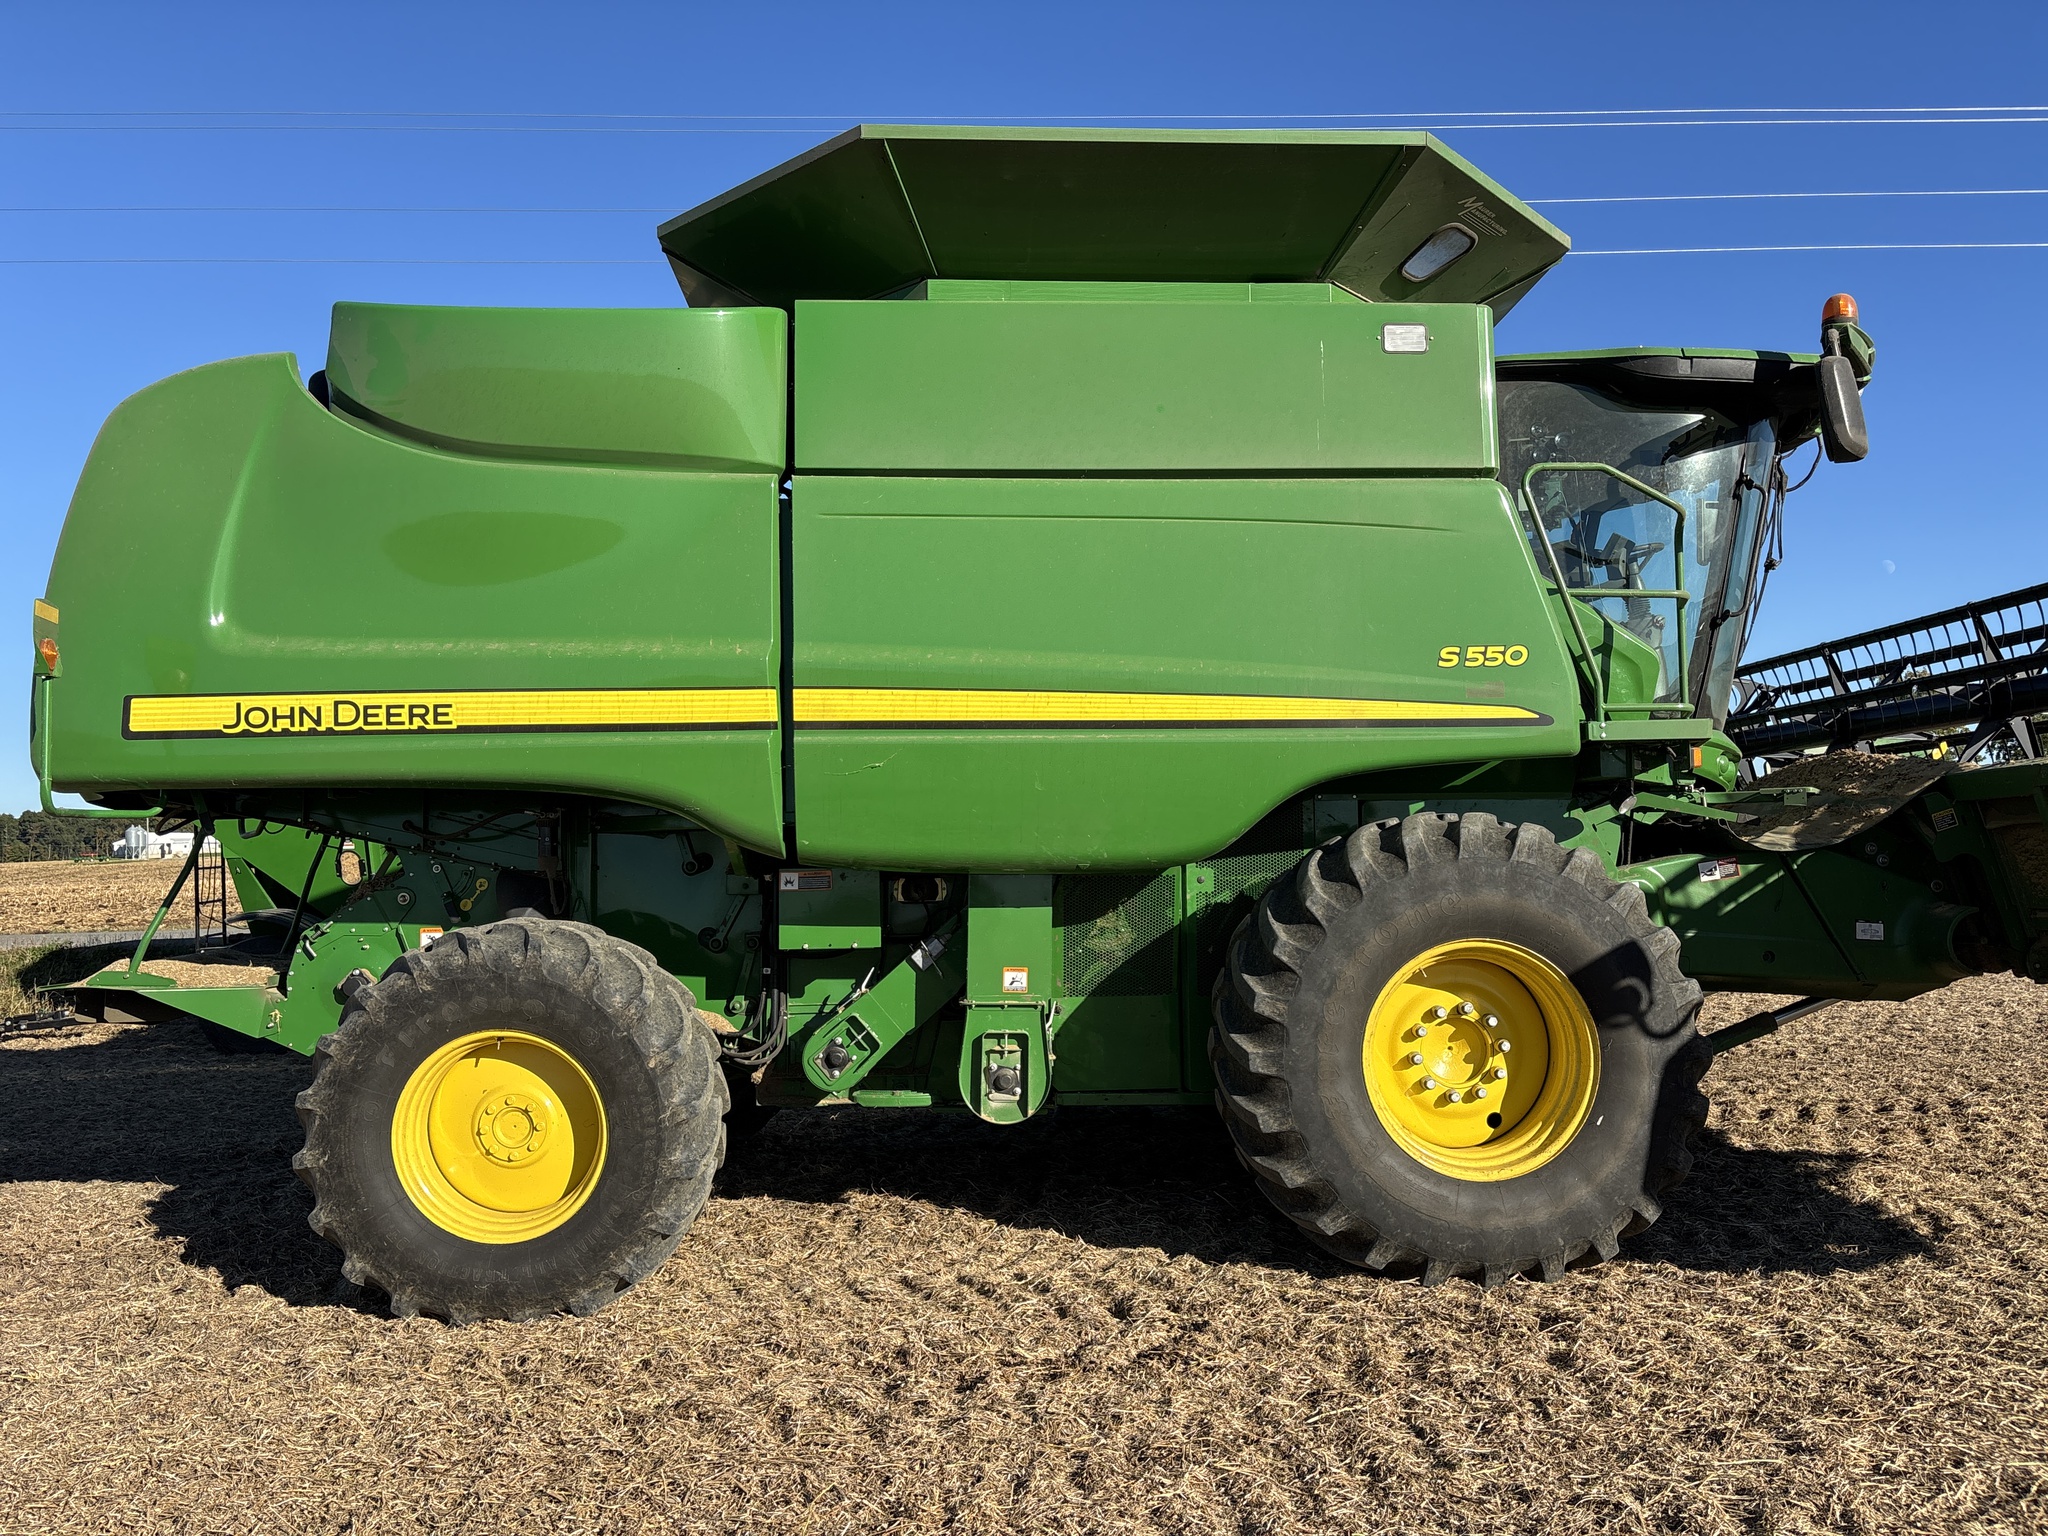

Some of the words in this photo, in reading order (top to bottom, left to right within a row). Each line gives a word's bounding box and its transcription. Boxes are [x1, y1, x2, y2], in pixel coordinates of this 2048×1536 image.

[1437, 645, 1461, 669] S
[1464, 644, 1530, 669] 550
[222, 702, 322, 729] JOHN
[333, 700, 453, 727] DEERE
